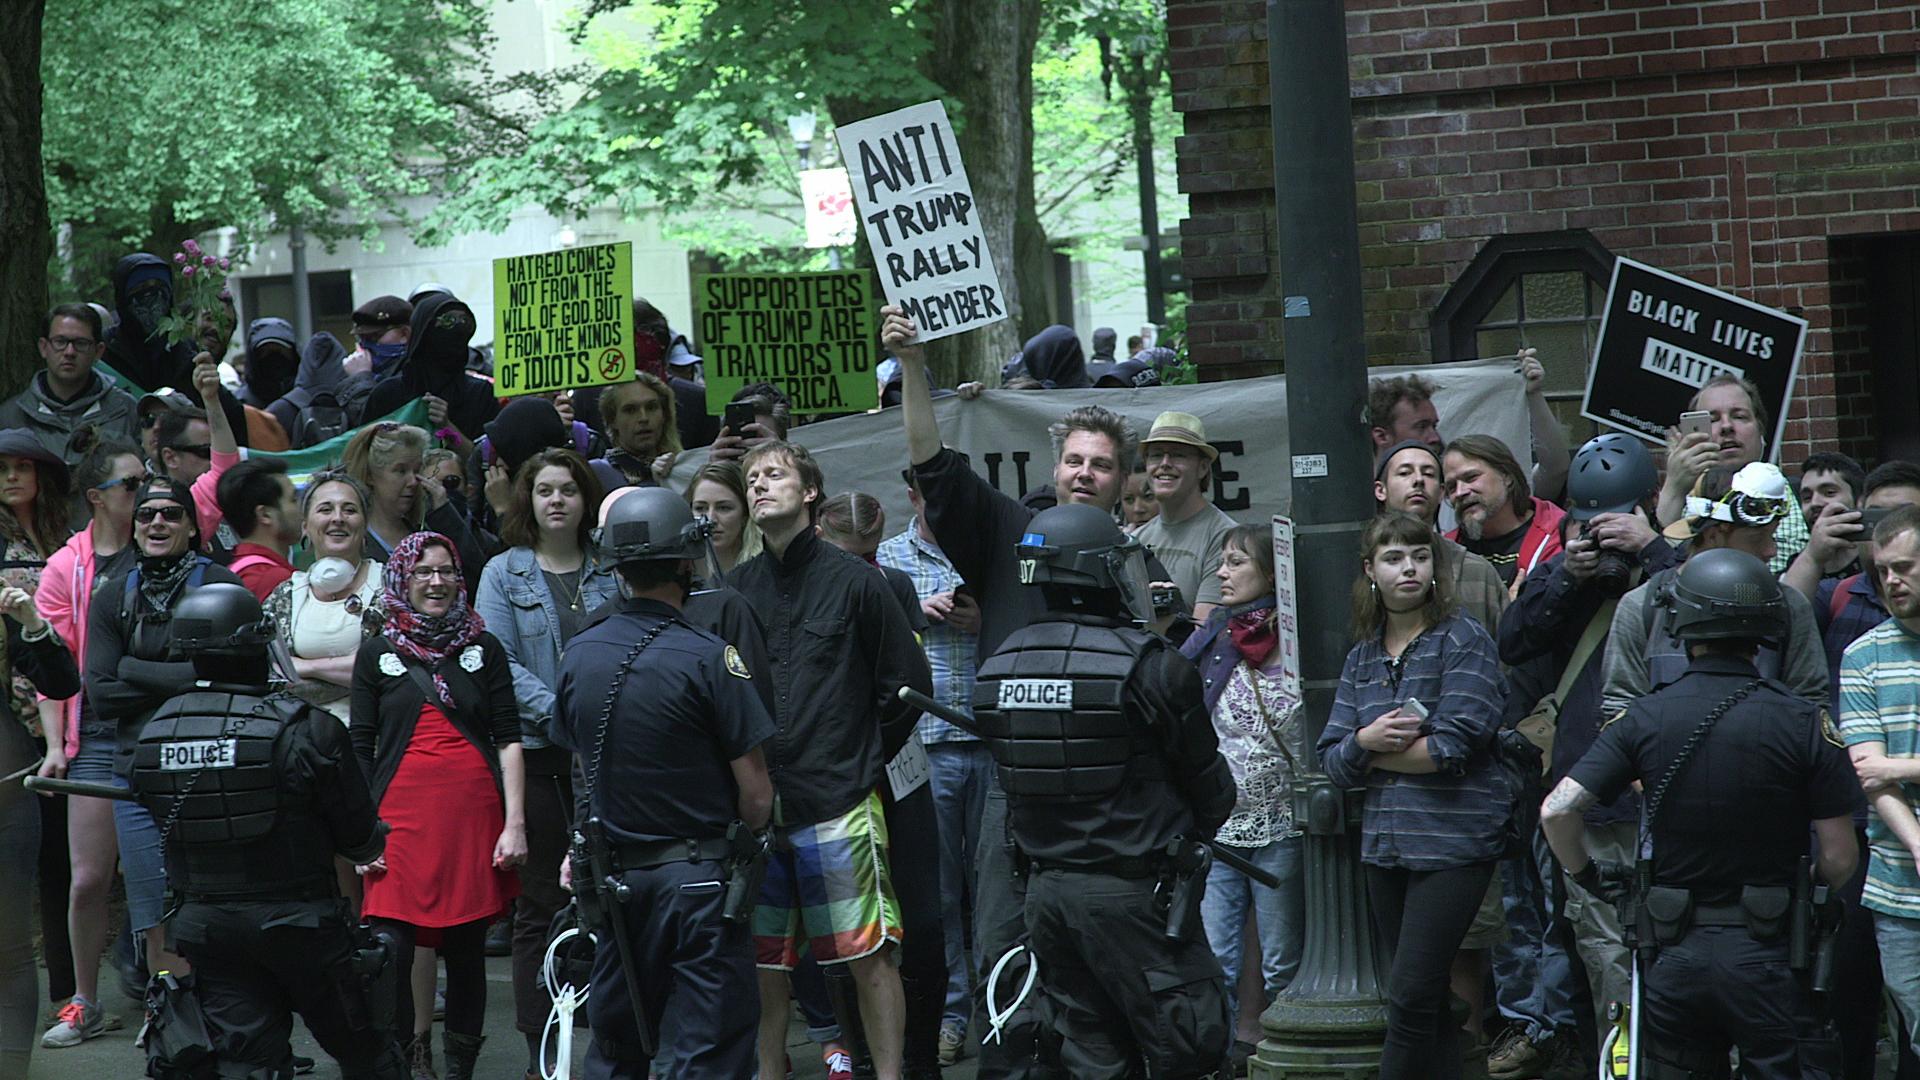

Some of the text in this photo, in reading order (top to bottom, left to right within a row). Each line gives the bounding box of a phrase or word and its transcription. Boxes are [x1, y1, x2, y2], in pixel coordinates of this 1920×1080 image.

[858, 122, 952, 204] ANTI
[867, 191, 972, 248] TRUMP
[507, 244, 616, 283] HATRED COMES
[886, 235, 981, 288] RALLY
[509, 271, 614, 308] NOT FROM THE
[706, 273, 863, 310] SUPPORTERS
[900, 284, 1002, 332] MEMBER
[502, 307, 536, 334] WILL
[540, 303, 558, 329] OF
[594, 295, 623, 323] BUT
[702, 307, 868, 344] OF TRUMP ARE
[1627, 289, 1775, 360] BLACK LIVES
[505, 321, 622, 360] FROM THE MINDS
[712, 340, 869, 378] TRAITORS TO
[502, 351, 594, 390] OF IDIOTS.
[743, 375, 849, 409] RICA.
[1003, 683, 1067, 704] POLICE
[165, 744, 229, 766] POLICE
